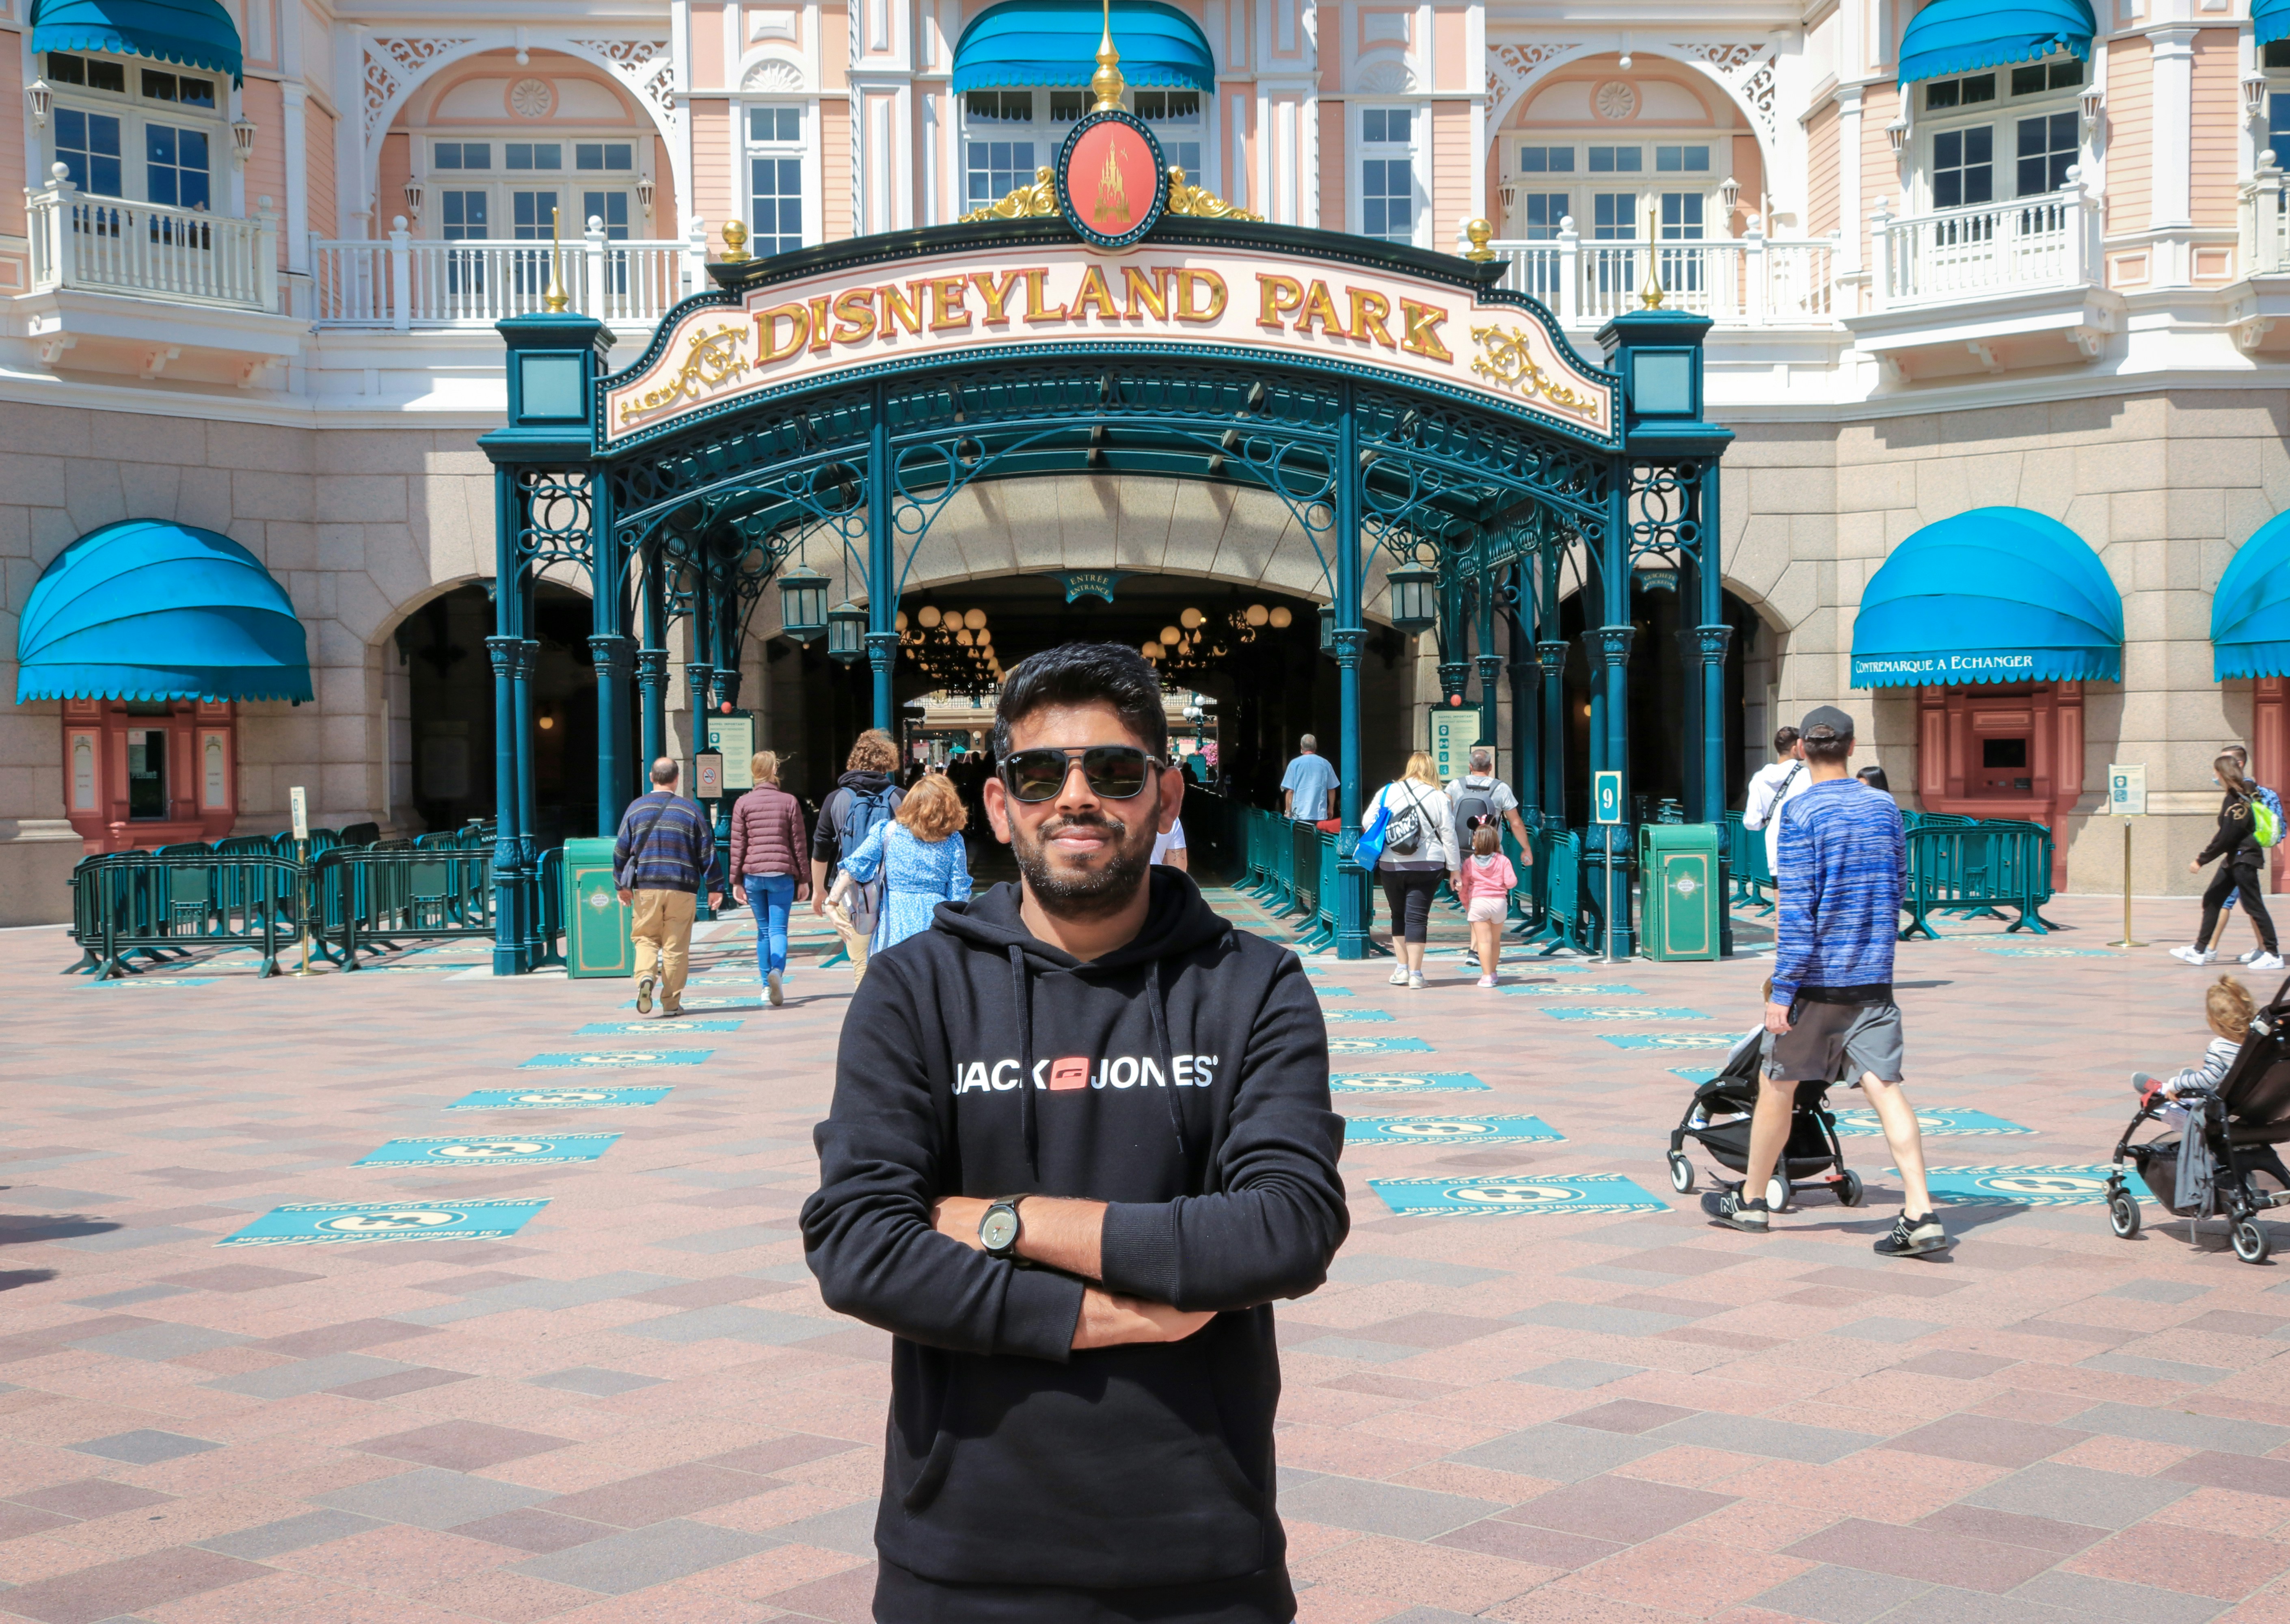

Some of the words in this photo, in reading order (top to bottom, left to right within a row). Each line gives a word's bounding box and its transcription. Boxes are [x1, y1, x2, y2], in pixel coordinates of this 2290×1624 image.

[752, 264, 1228, 367] DISNEYLAND
[1255, 272, 1454, 365] PARK
[1070, 574, 1109, 585] ENTRÉE
[1070, 584, 1110, 596] ENTRANCE
[1856, 660, 1934, 673] CONTREMARQUE
[1937, 659, 1947, 670] A
[1951, 656, 2033, 669] ECHANGER
[1603, 788, 1613, 809] 9
[951, 1059, 1050, 1095] JACK
